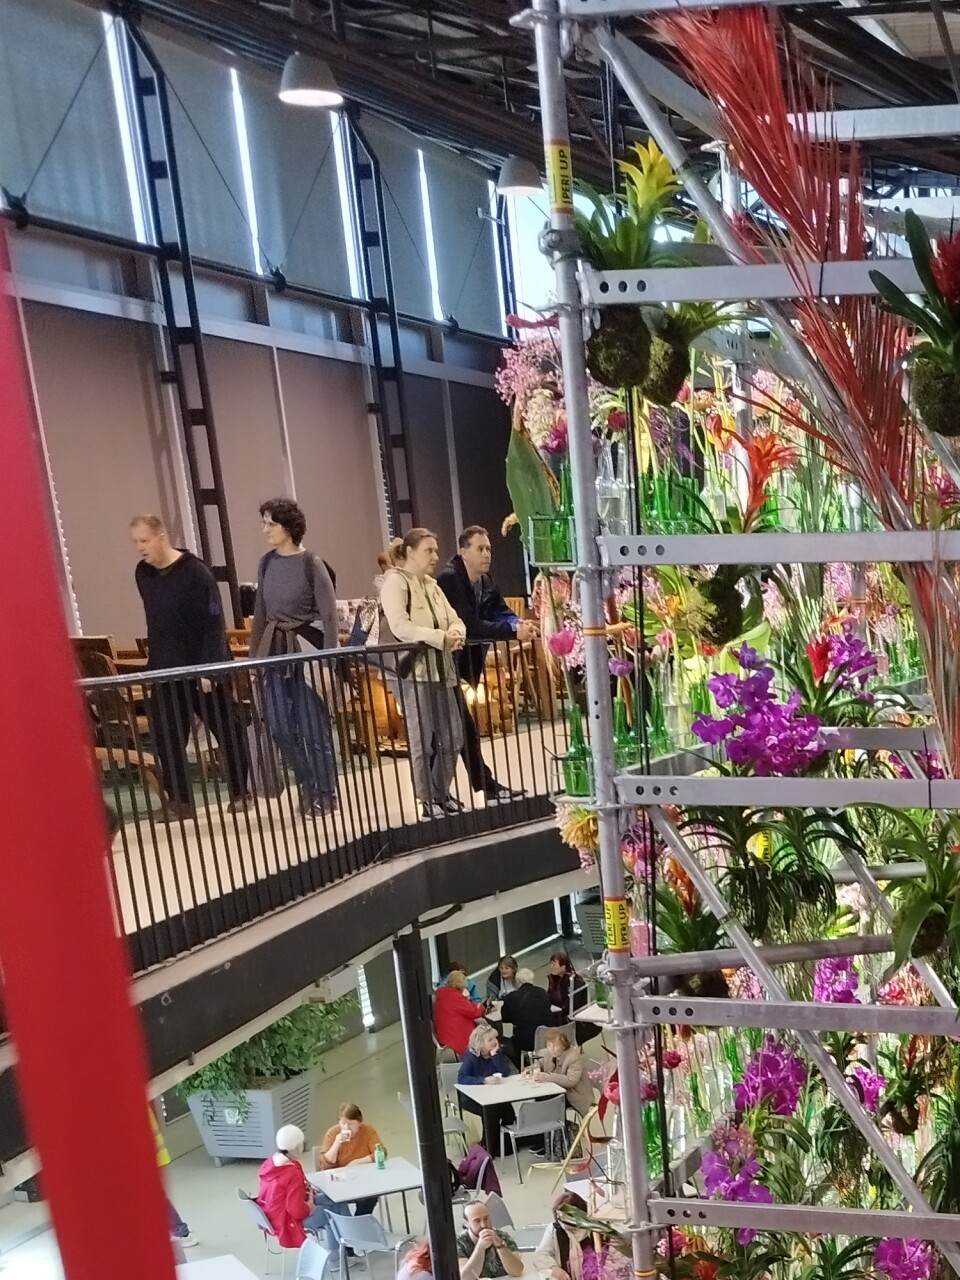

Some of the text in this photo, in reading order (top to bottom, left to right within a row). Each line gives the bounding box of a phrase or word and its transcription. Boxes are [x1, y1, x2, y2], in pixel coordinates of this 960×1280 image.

[559, 149, 572, 201] PERI UP
[619, 904, 627, 920] UP
